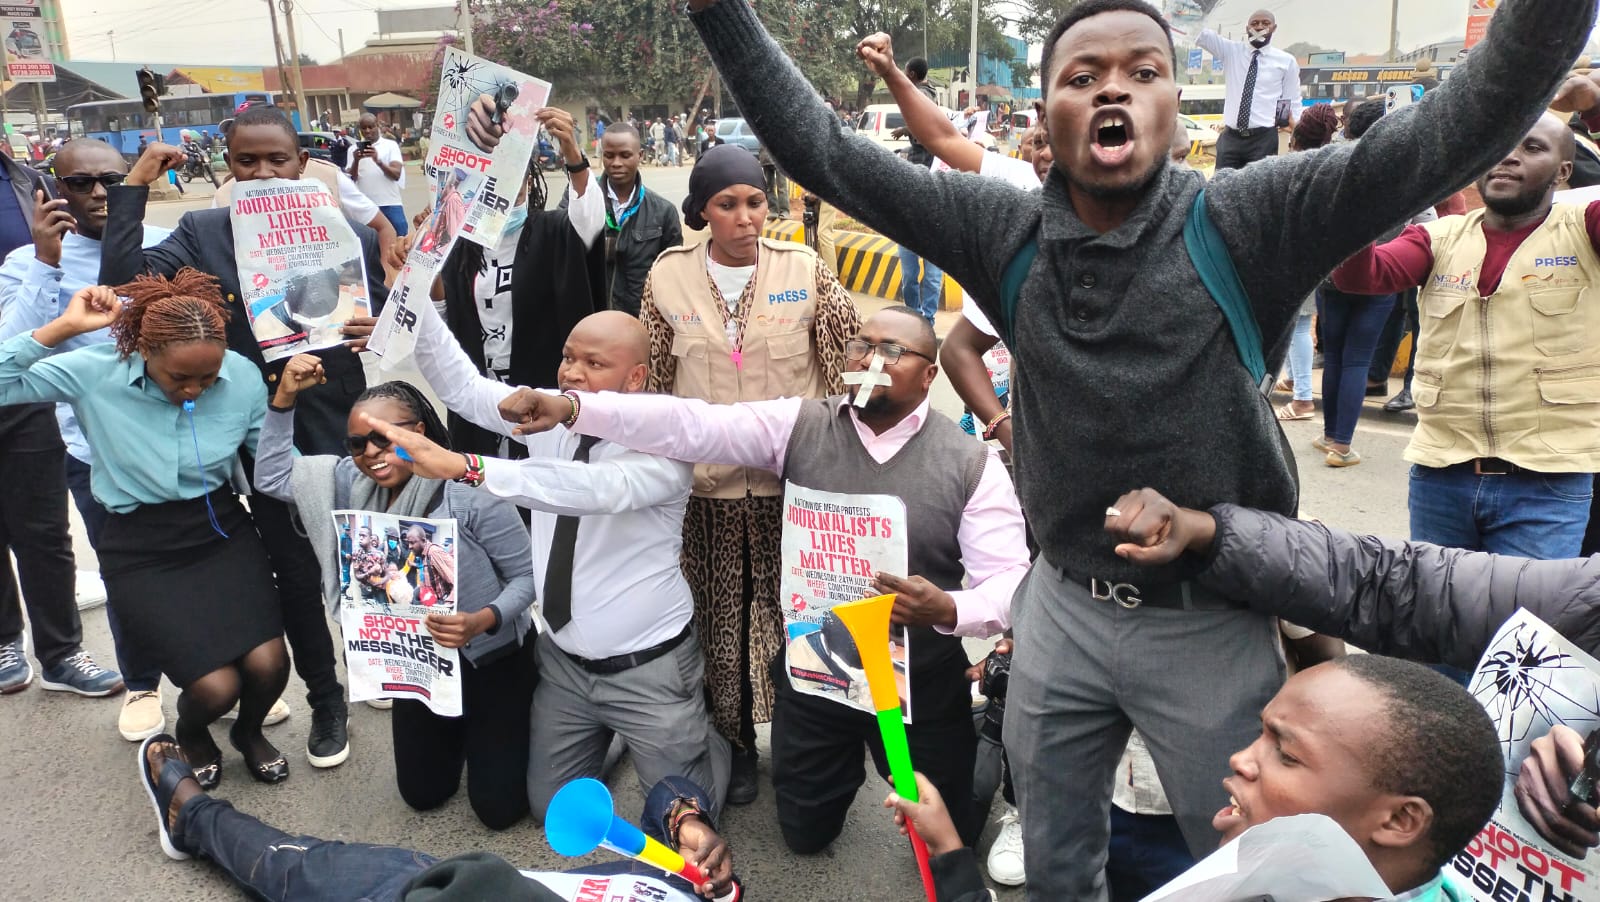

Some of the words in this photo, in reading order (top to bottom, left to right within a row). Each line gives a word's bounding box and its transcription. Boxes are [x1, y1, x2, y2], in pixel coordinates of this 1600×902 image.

[440, 145, 493, 173] SHOOT
[235, 192, 339, 216] JOURNALISTS
[267, 210, 313, 230] LIVES
[258, 225, 330, 249] MATTER
[265, 246, 297, 257] WEDNESDAY
[298, 244, 312, 253] 24TH
[313, 243, 323, 251] JULY
[325, 241, 339, 250] 2024
[287, 251, 325, 261] COUNTRYWIDE
[288, 259, 322, 269] JOURNALISTS
[1535, 256, 1578, 268] PRESS
[768, 289, 808, 305] PRESS
[841, 506, 871, 517] PROTESTS
[787, 504, 892, 539] JOURNALISTS
[810, 531, 857, 556] LIVES
[800, 549, 874, 578] MATTER
[805, 570, 838, 583] WEDNESDAY
[838, 575, 854, 585] 24TH
[854, 577, 867, 587] JULY
[363, 615, 420, 633] SHOOT
[358, 628, 391, 641] NOT
[395, 631, 434, 652] THE
[348, 640, 454, 677] MESSENGER
[383, 658, 413, 668] WEDNESDAY
[413, 663, 425, 671] 24TH
